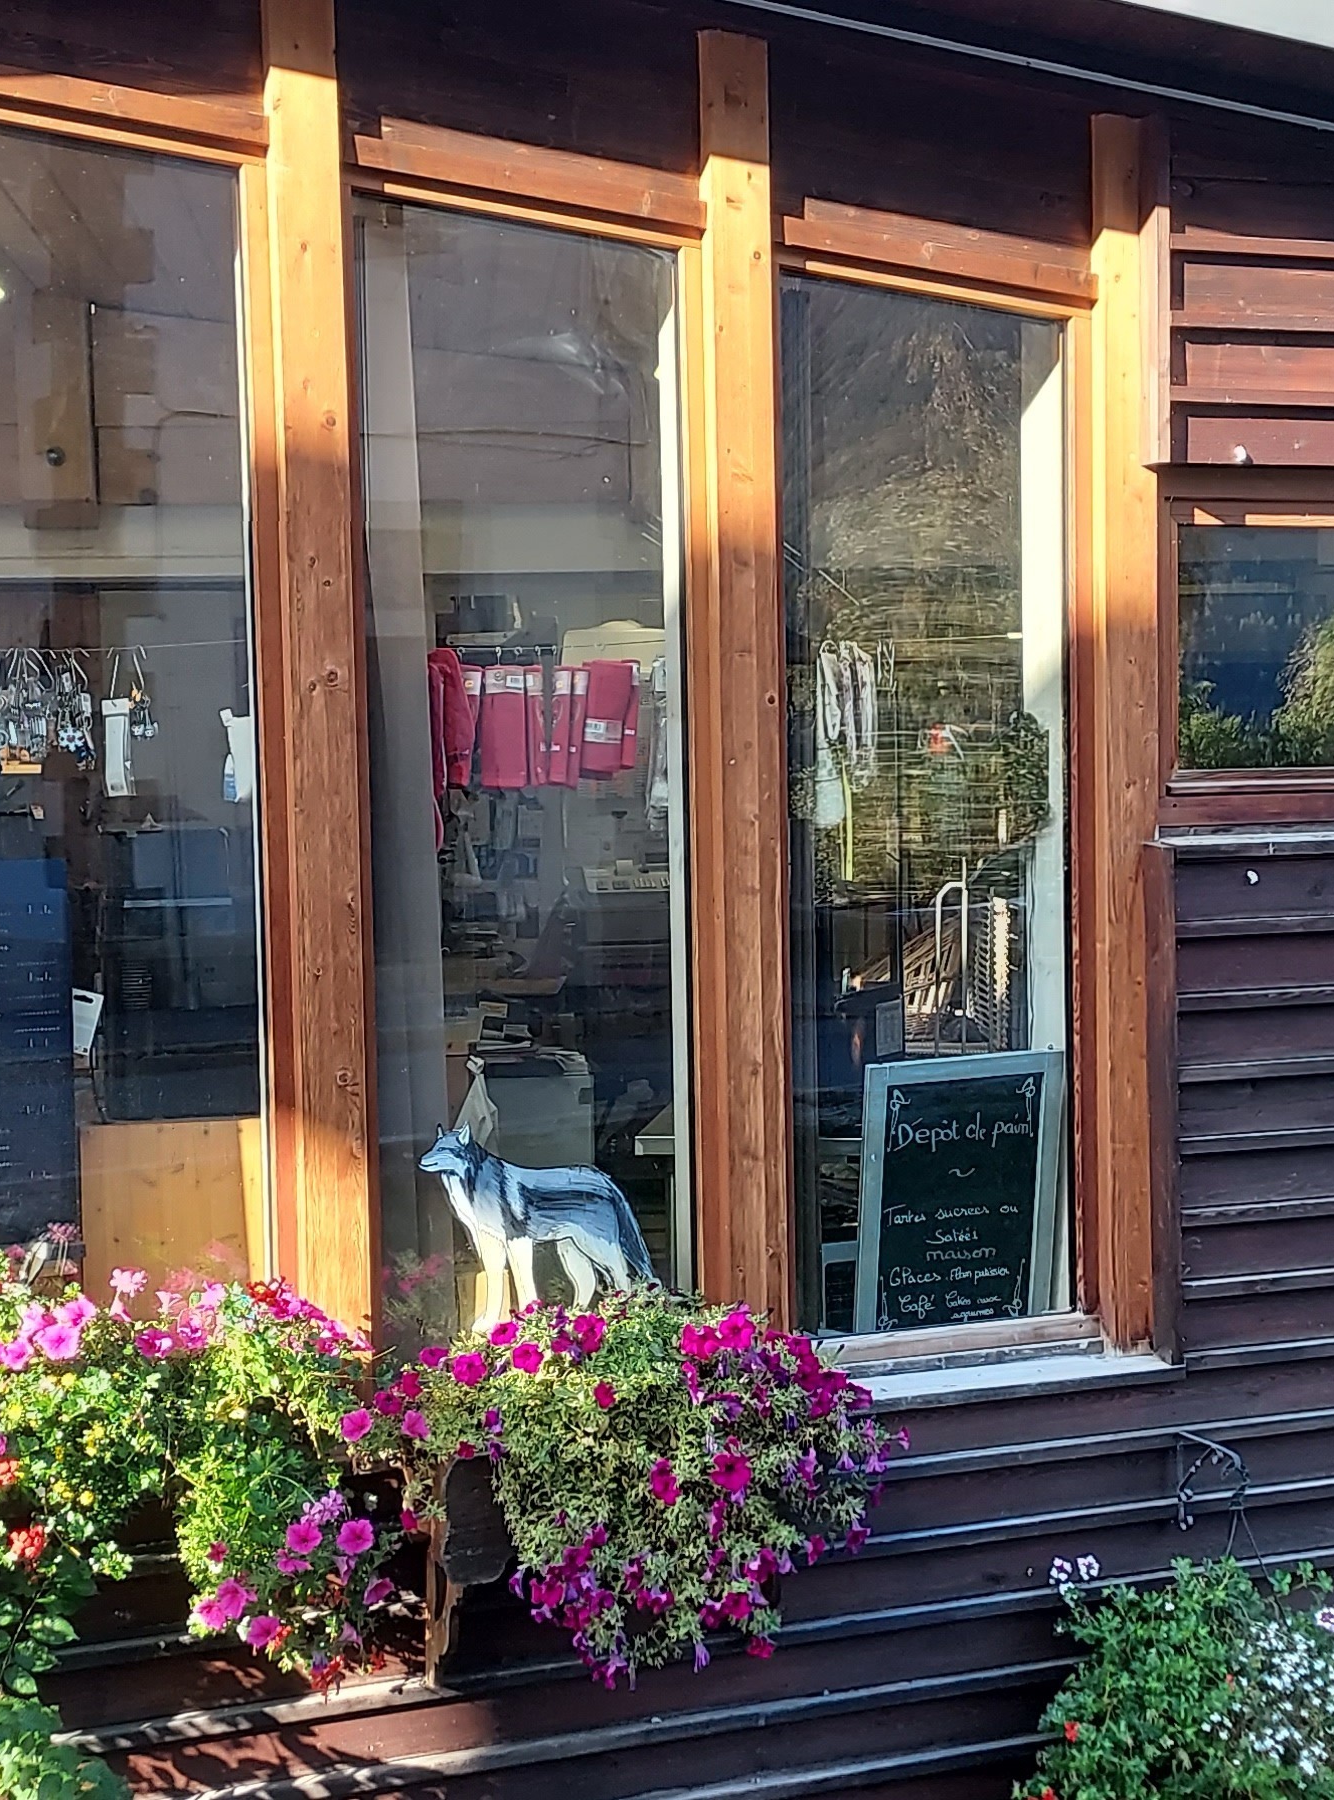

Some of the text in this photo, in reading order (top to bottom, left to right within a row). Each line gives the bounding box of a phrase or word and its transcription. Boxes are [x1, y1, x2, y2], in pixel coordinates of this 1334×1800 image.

[893, 1111, 1029, 1152] Dépôt de pain
[883, 1203, 927, 1227] Tartes
[999, 1204, 1019, 1214] ou
[926, 1246, 996, 1262] maison
[898, 1293, 936, 1320] Café
